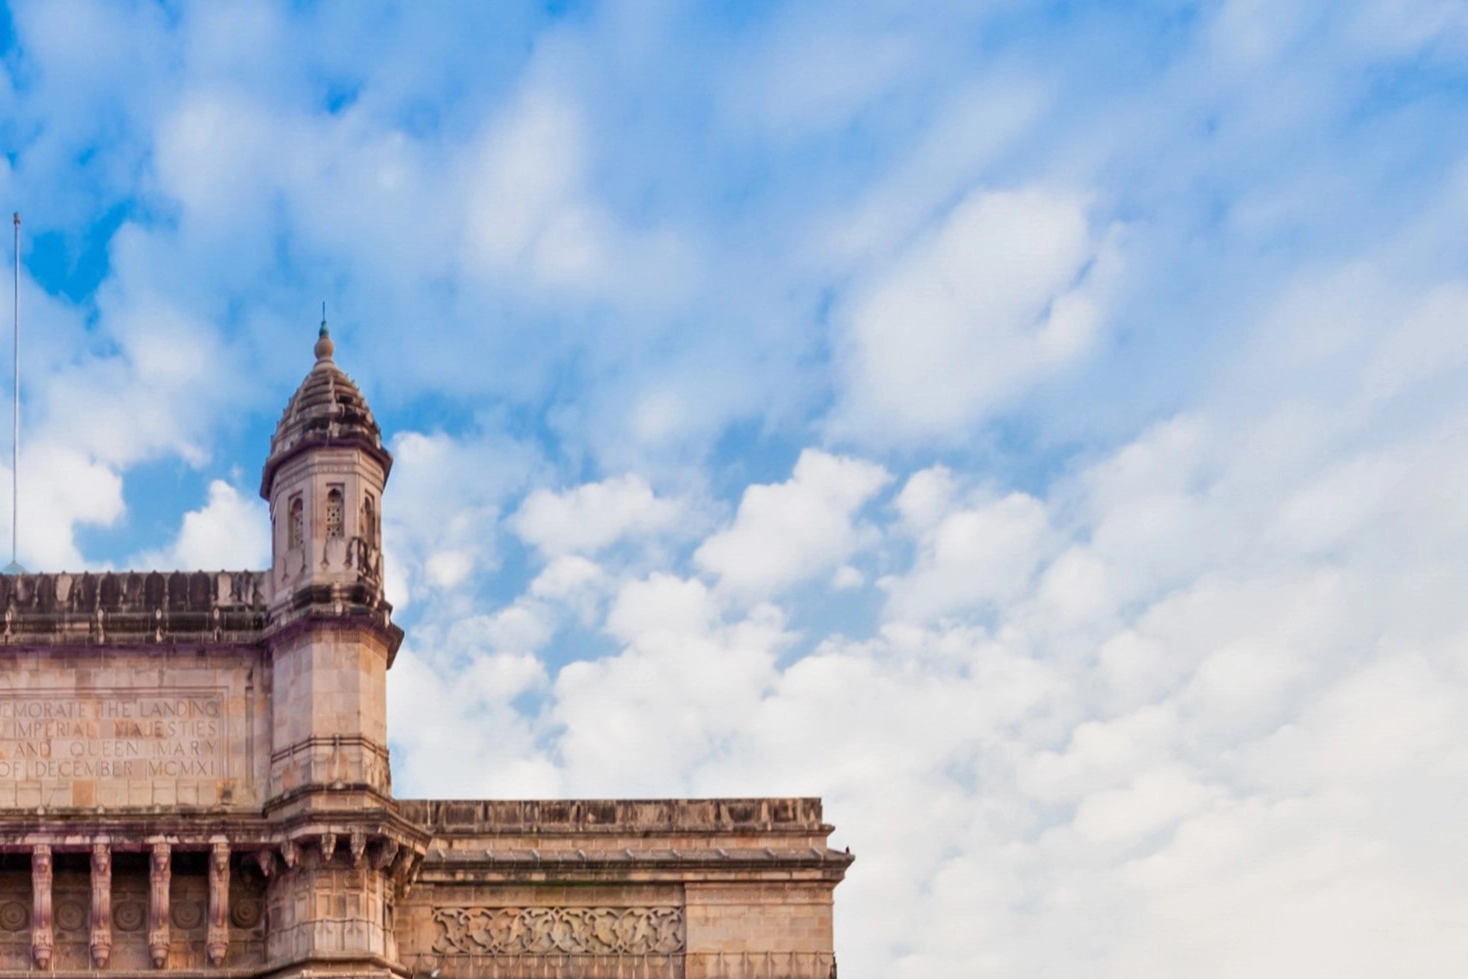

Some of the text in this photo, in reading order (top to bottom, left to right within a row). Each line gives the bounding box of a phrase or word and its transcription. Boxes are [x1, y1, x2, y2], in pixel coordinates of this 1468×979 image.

[100, 702, 131, 718] THE
[140, 701, 220, 718] LANDING
[13, 721, 94, 738] IMPERIAL
[115, 721, 217, 738] MAJESTIES
[15, 741, 51, 758] AND
[70, 740, 139, 757] QUEEN
[158, 740, 217, 757] MARY
[36, 761, 132, 777] DECEMBER
[148, 760, 214, 777] MCMXI
